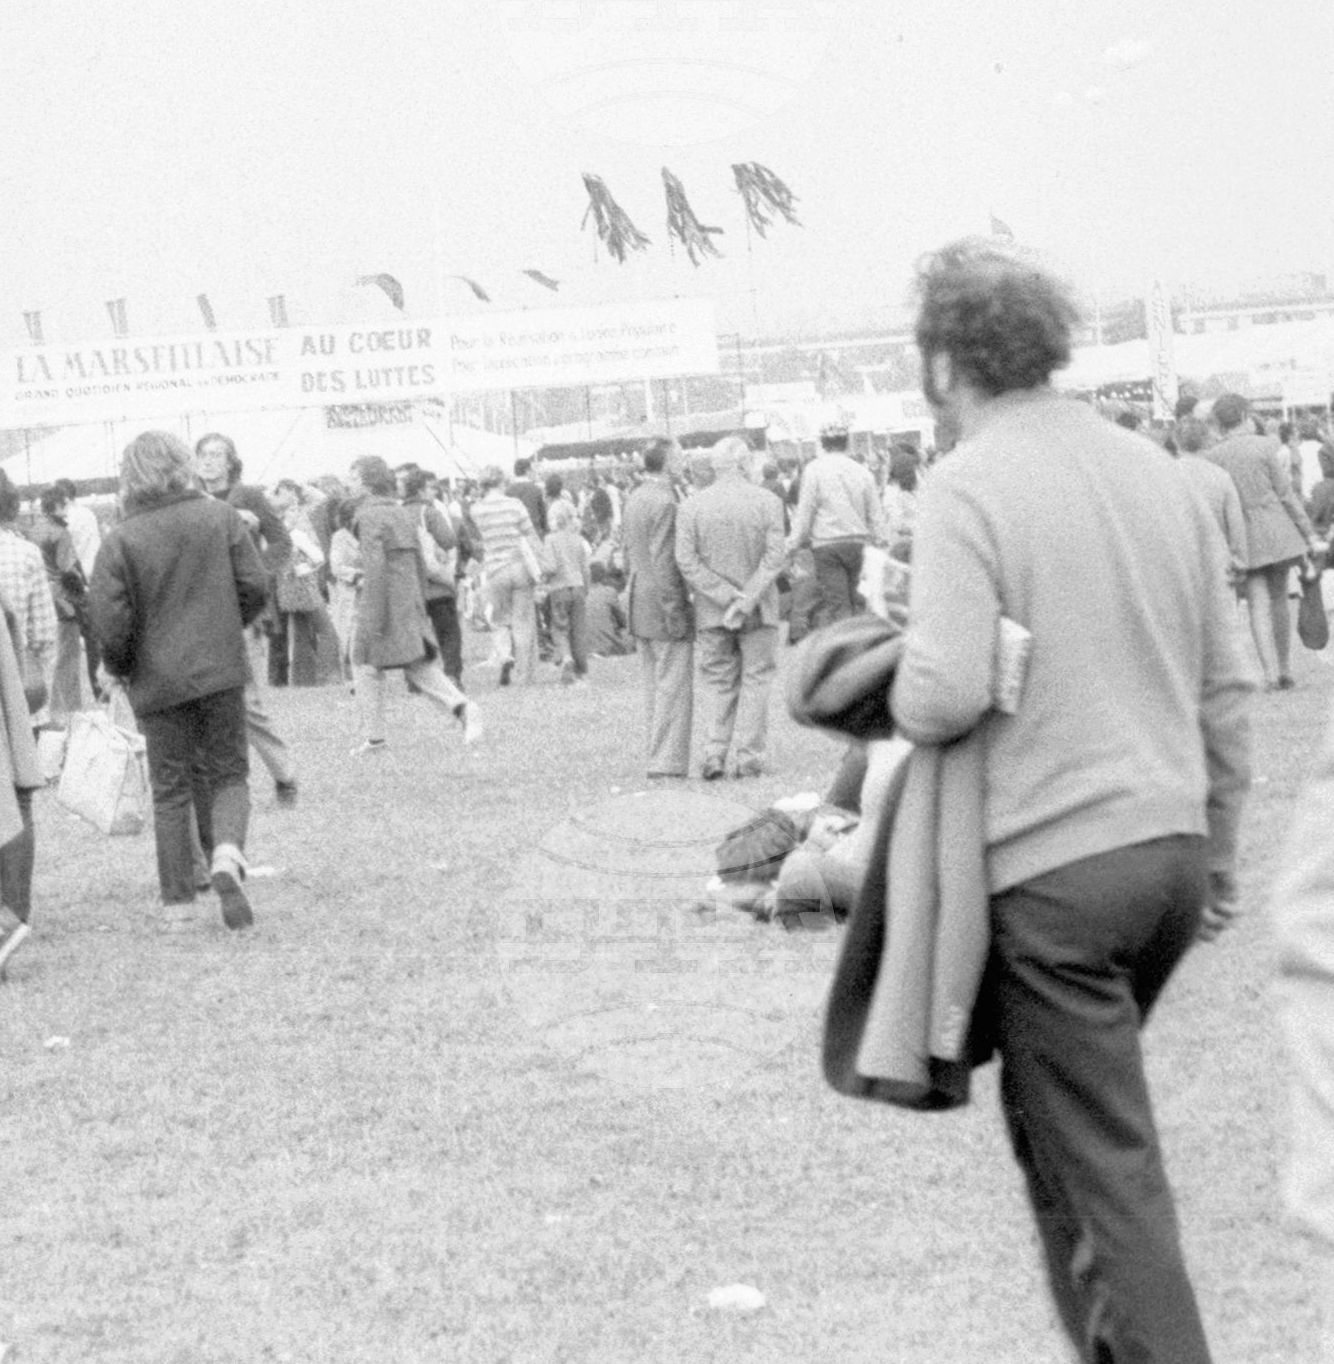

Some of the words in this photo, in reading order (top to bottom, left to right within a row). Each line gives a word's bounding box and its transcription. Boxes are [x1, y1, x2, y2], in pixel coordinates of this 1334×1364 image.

[300, 334, 336, 357] AU
[15, 354, 54, 383] LA
[64, 337, 279, 380] MARSEILLAISE
[65, 383, 132, 399] QUOTIDIEN
[300, 369, 346, 394] DES
[354, 363, 436, 391] LUTTES
